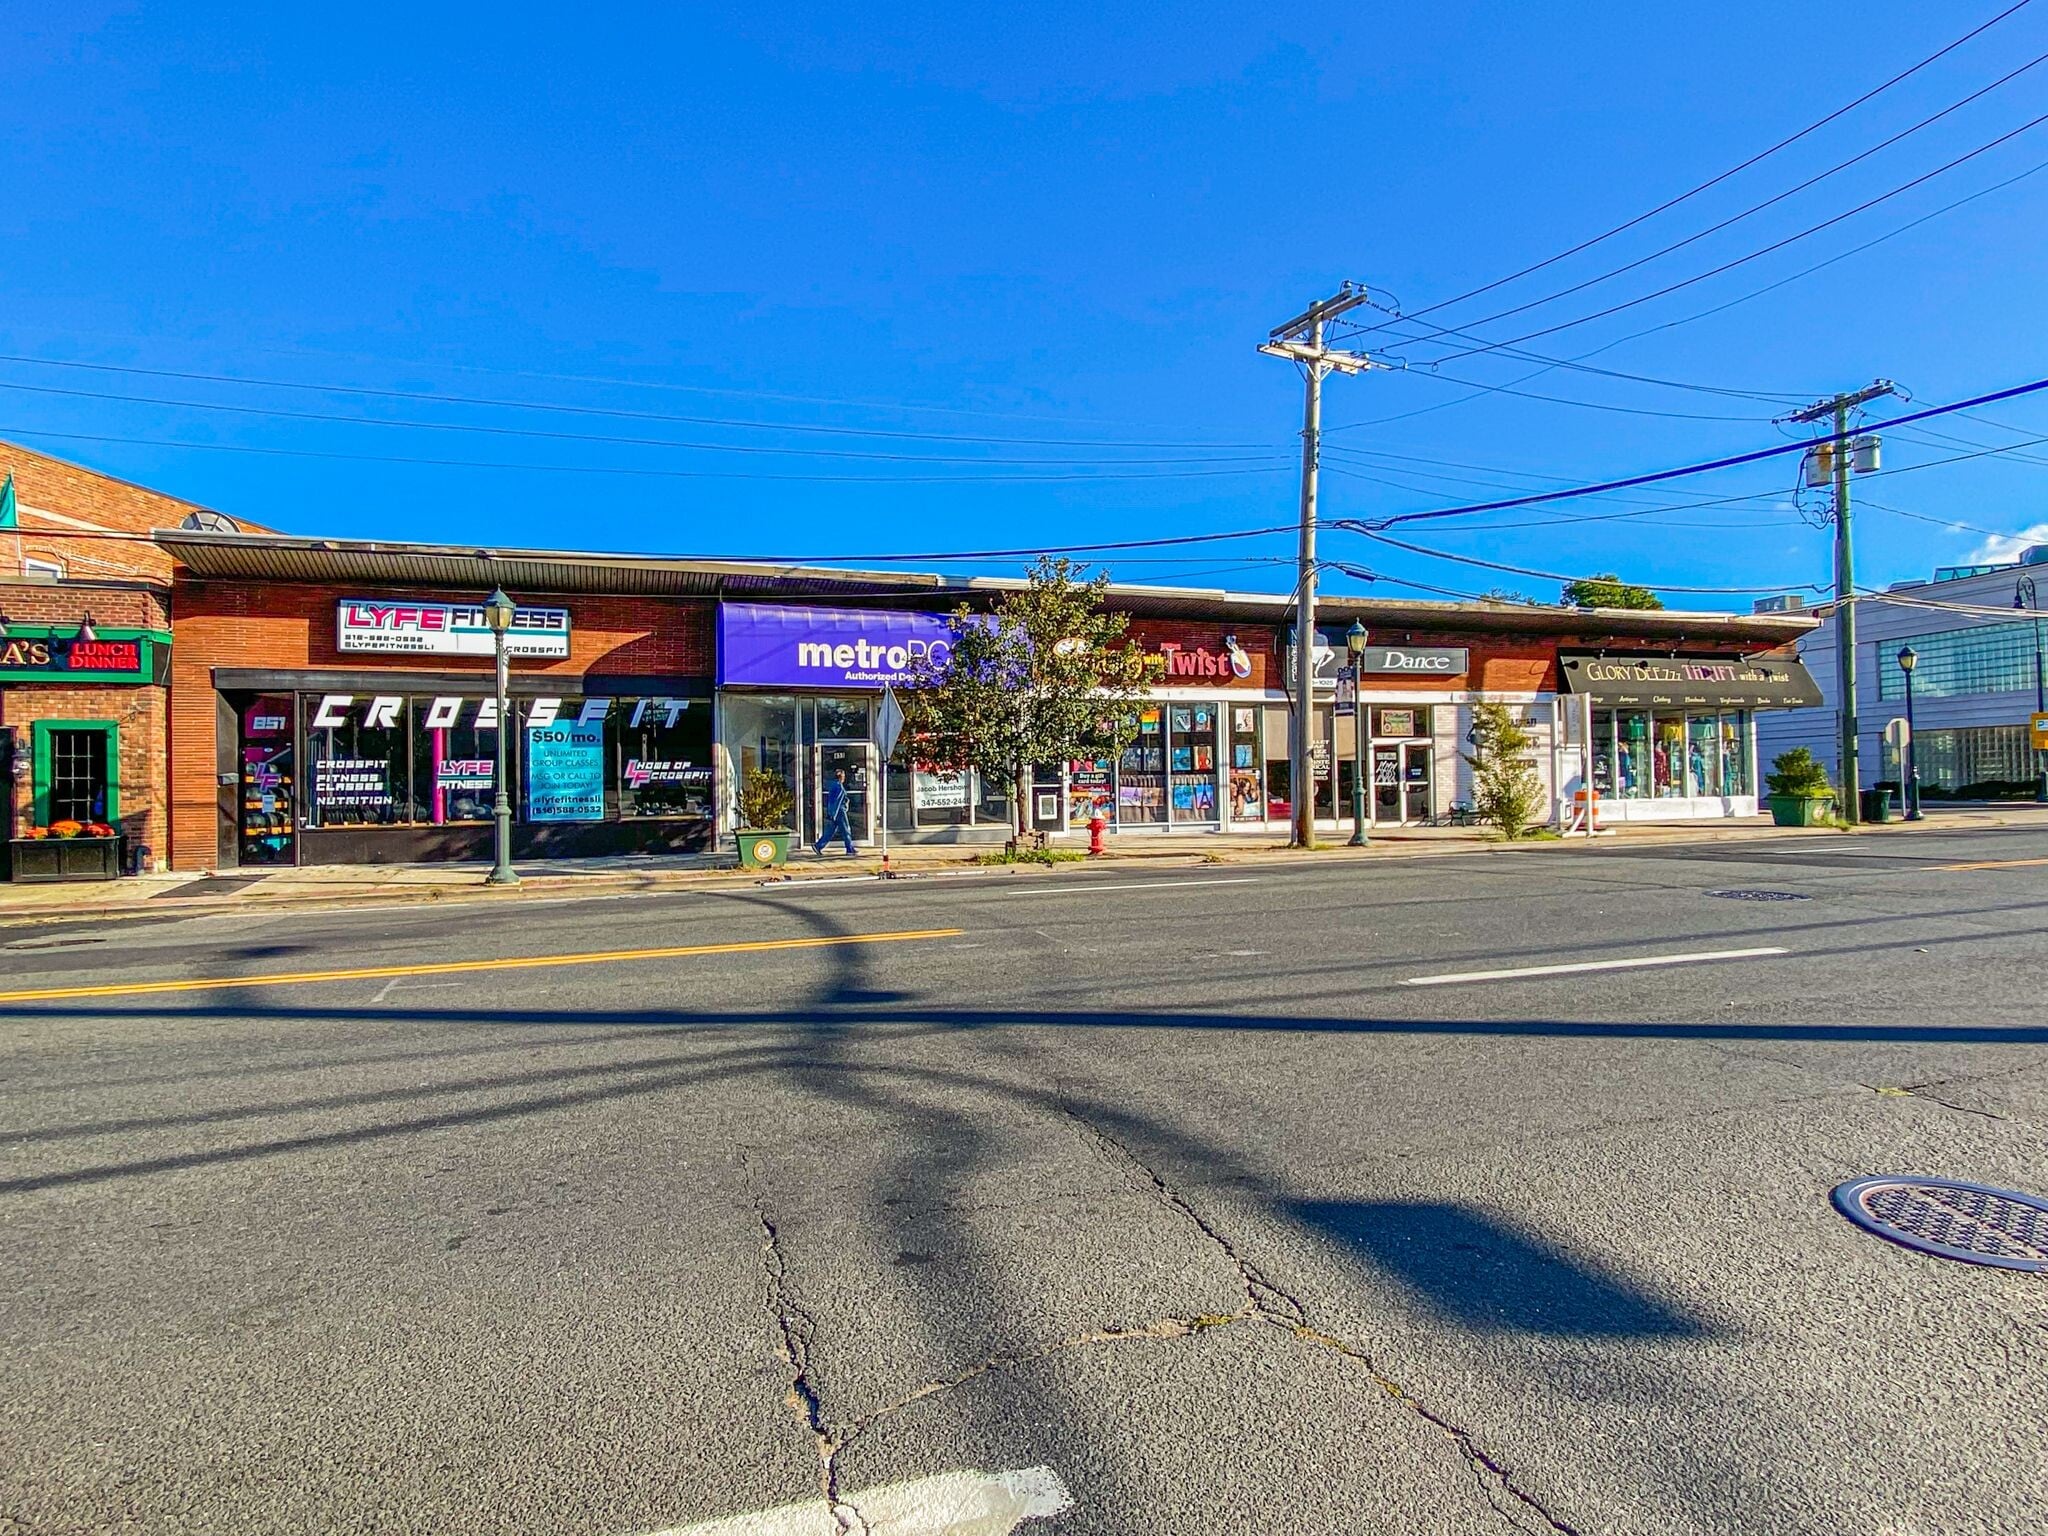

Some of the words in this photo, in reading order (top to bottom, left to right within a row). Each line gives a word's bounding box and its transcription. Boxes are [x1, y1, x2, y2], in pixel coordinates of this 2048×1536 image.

[345, 603, 446, 631] LYFE
[452, 608, 563, 629] FITESS
[74, 643, 137, 656] LUNCH
[506, 646, 564, 654] CROSSFIT
[798, 638, 957, 670] metroPC
[69, 656, 139, 669] DINNER
[1160, 643, 1229, 676] Twist
[1382, 651, 1450, 669] Dance
[845, 671, 897, 682] Authorized
[1587, 663, 1631, 681] GLORY
[1681, 664, 1736, 682] THRIFT
[1739, 669, 1758, 681] with
[313, 695, 690, 728] CROSSFIT
[253, 716, 286, 730] 851
[532, 729, 600, 743] $50/mo.
[544, 750, 588, 758] UNLIMITED
[316, 760, 388, 769] CROSSFIT
[438, 760, 494, 776] LYFE
[637, 762, 671, 770] HOME
[673, 762, 692, 770] OF
[316, 774, 380, 783] FITNESS
[532, 772, 550, 780] MSG
[553, 772, 565, 780] OR
[567, 772, 586, 780] CALL
[590, 772, 601, 780] TO
[650, 771, 712, 780] CROSSFIT
[316, 783, 384, 792] CLASSES
[437, 780, 493, 789] FITNESS
[564, 782, 593, 790] TODAY!
[916, 785, 938, 793] Jacob
[316, 796, 392, 805] NUTRITION
